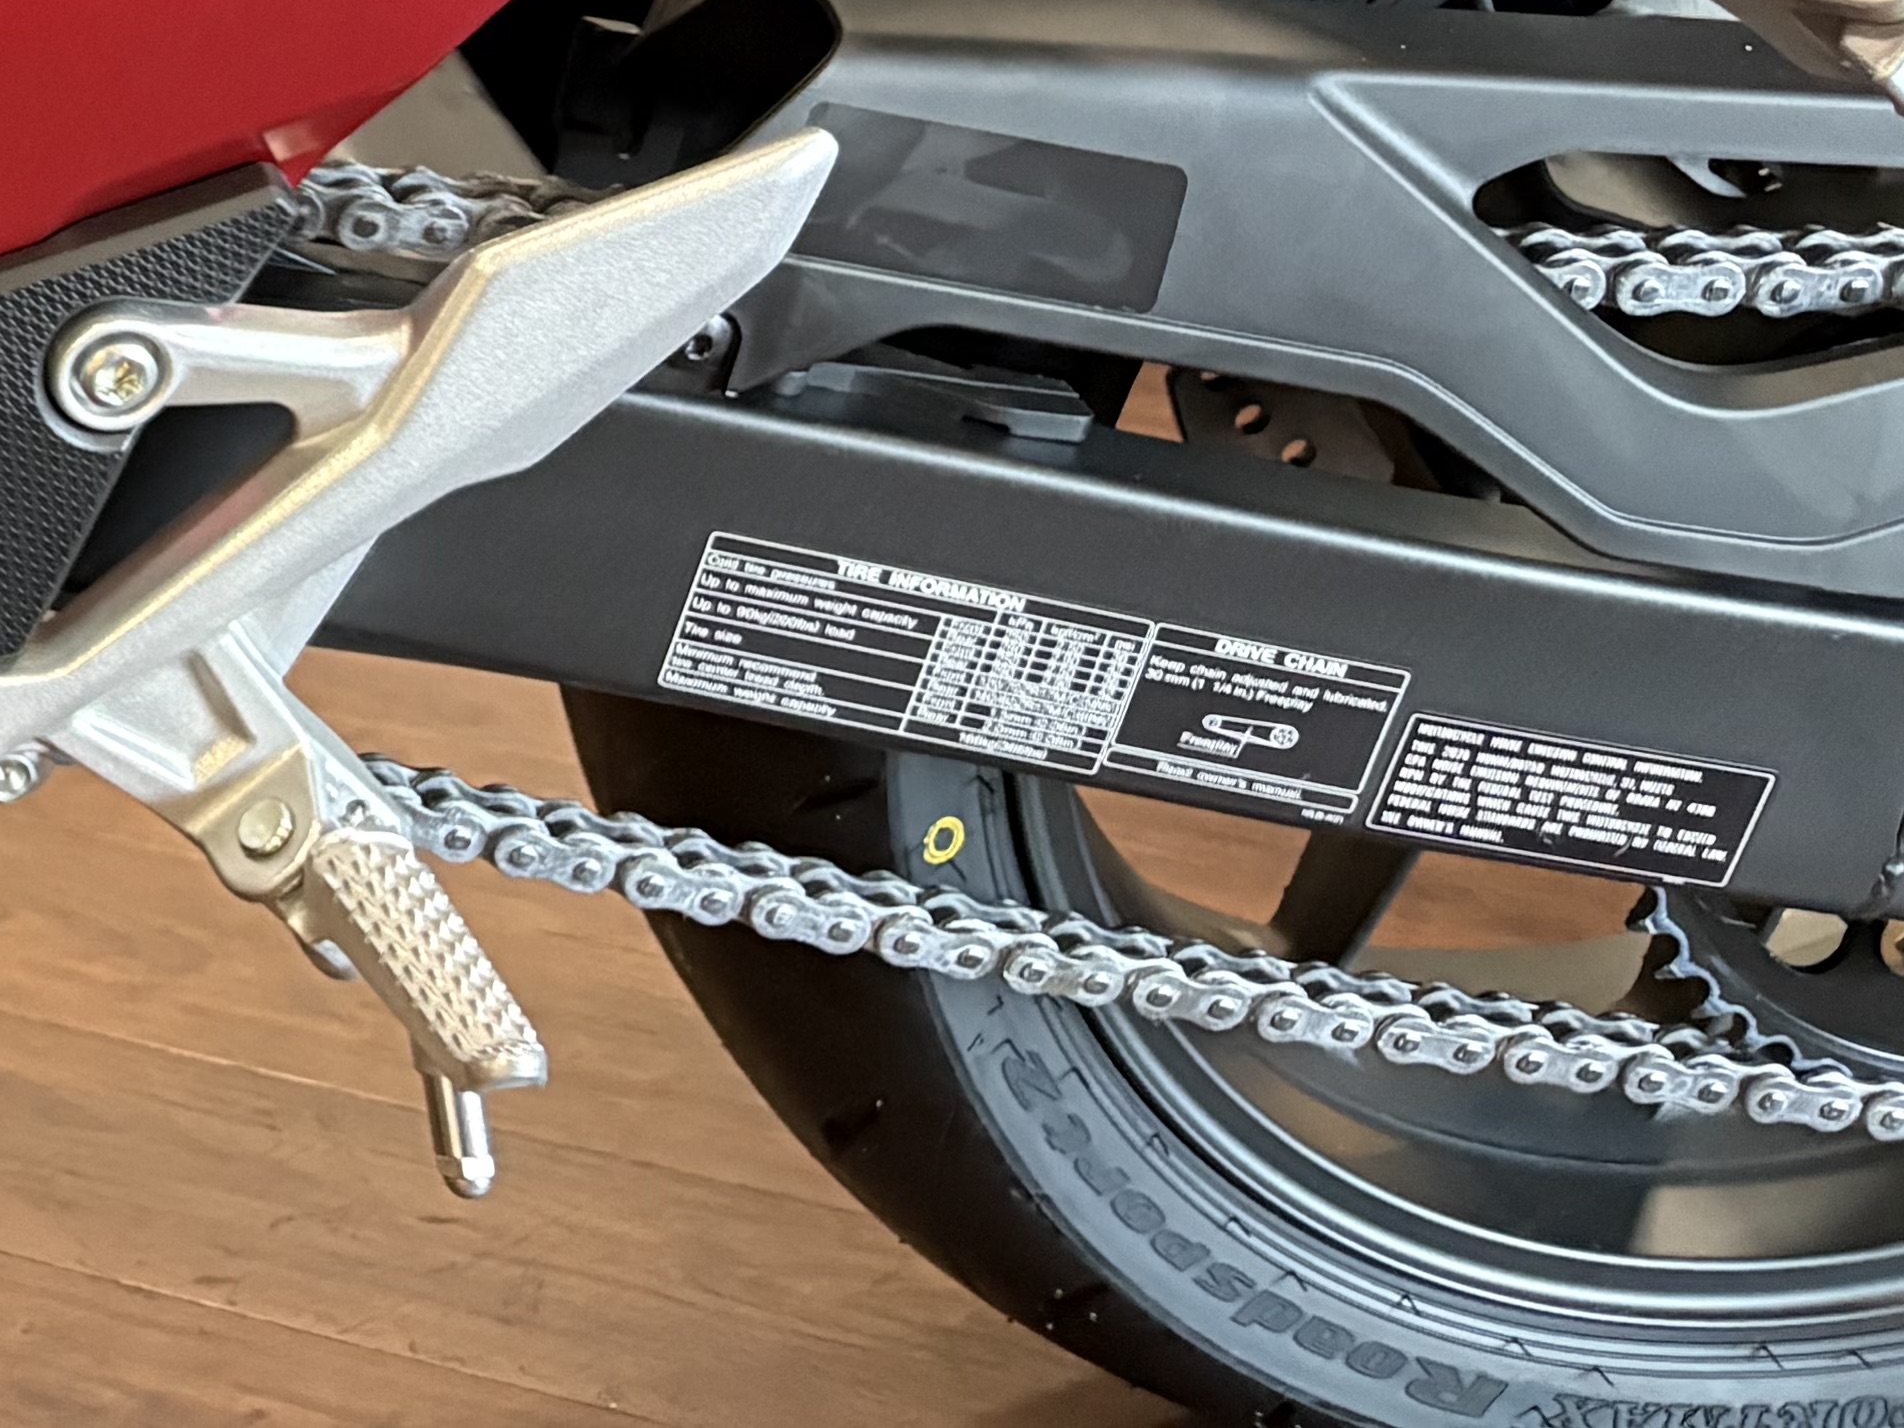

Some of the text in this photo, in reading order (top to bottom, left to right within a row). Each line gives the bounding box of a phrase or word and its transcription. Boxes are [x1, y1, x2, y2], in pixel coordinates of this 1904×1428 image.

[700, 572, 918, 629] Up to maximum weight capacity
[833, 558, 1027, 614] TIRE INFORMATION
[684, 620, 742, 644] Tire size
[691, 596, 712, 611] Up
[716, 601, 731, 615] to
[824, 623, 855, 640] load
[1144, 667, 1163, 680] 30
[1164, 673, 1190, 686] mm
[1147, 654, 1185, 673] Keep
[1189, 664, 1226, 680] chain
[1291, 685, 1319, 699] and
[1213, 637, 1349, 678] DRIVE CHAIN
[1001, 1049, 1063, 1112] 2
[1042, 1112, 1509, 1417] Roadsport
